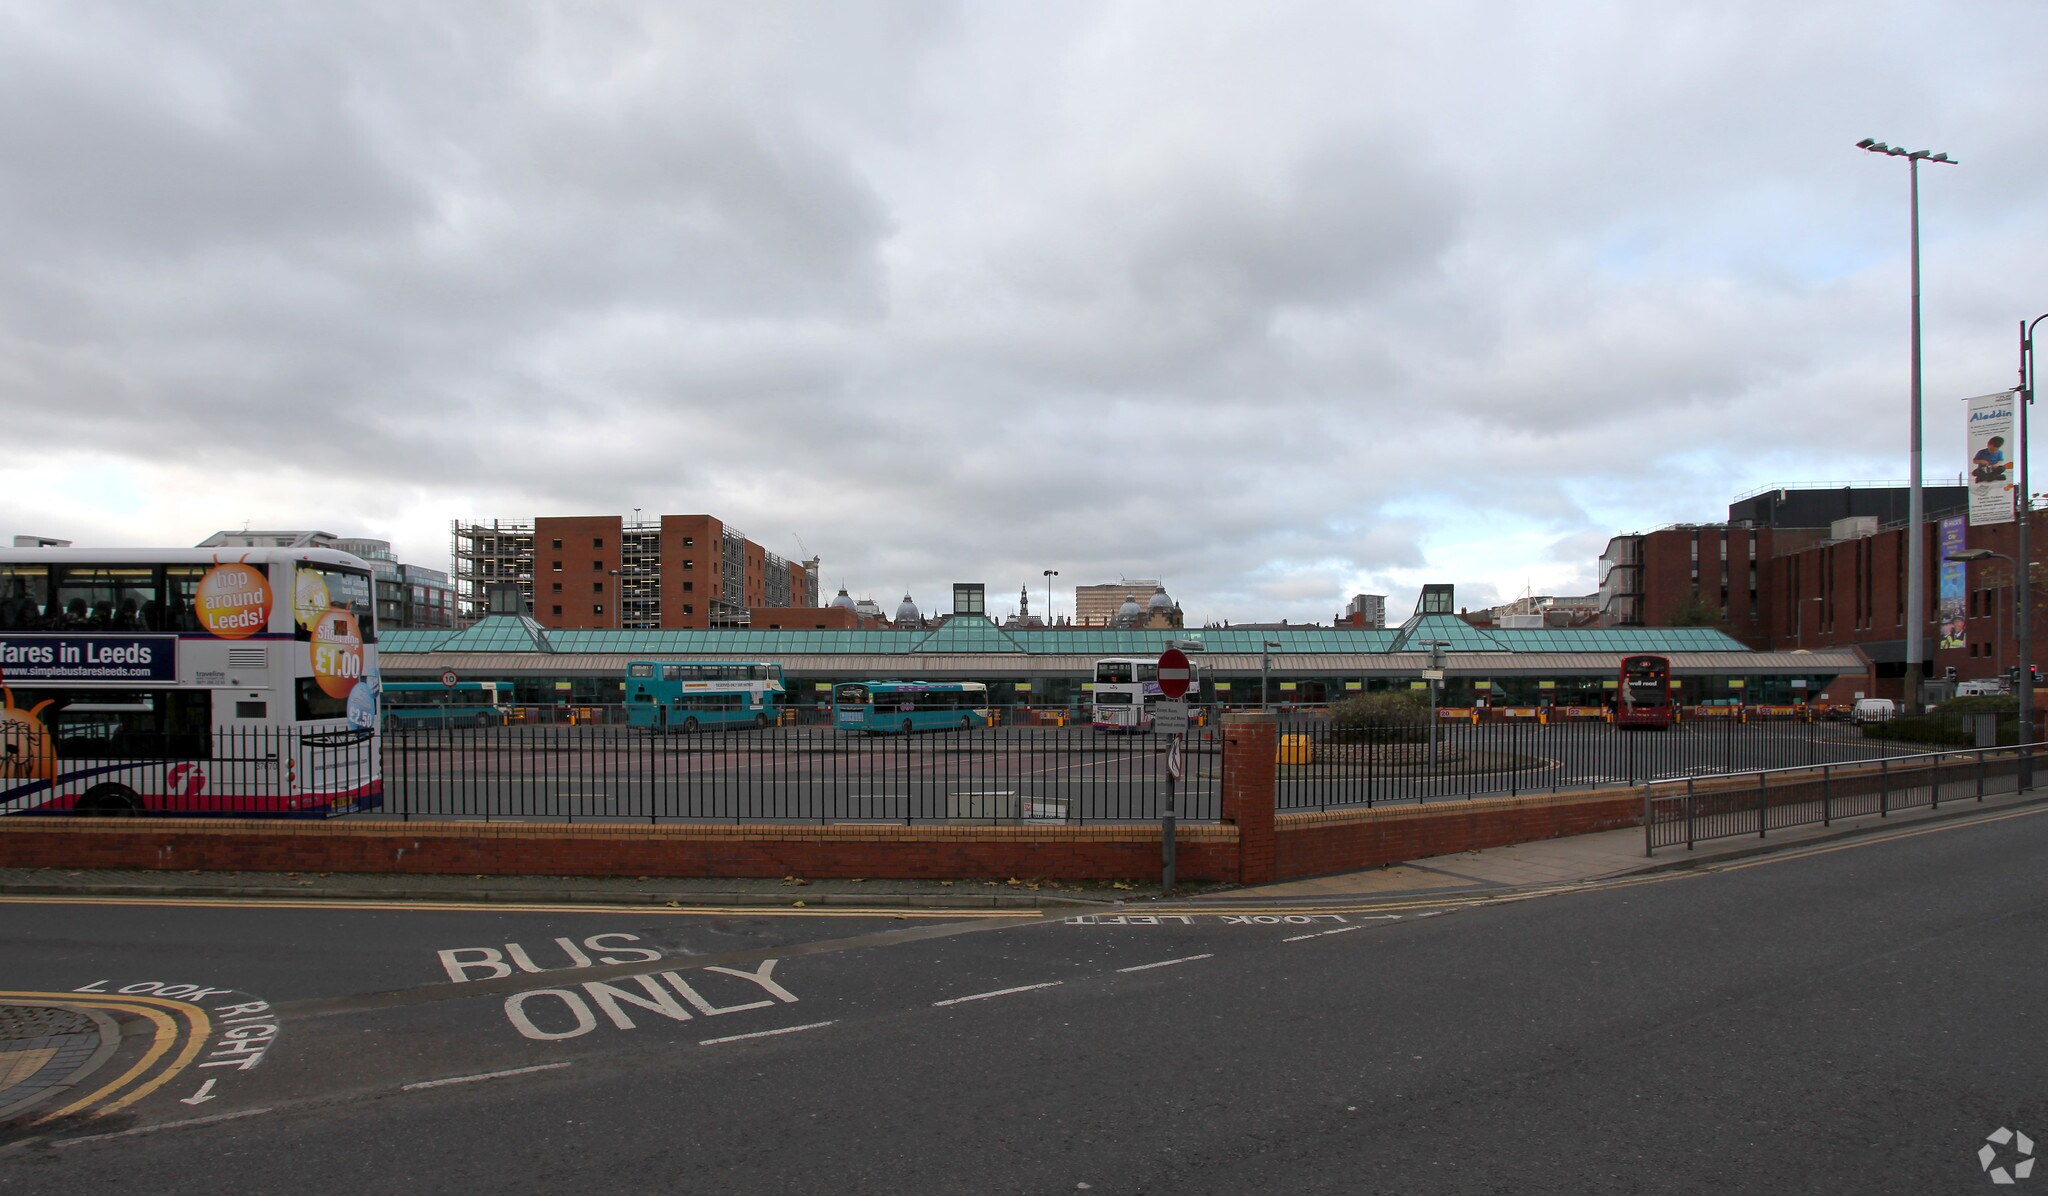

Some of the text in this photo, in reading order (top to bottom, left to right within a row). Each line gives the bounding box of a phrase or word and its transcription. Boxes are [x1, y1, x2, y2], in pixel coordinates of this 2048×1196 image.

[1969, 409, 2013, 423] Aladdin
[216, 571, 248, 589] hop
[205, 588, 264, 609] around
[208, 608, 264, 629] Leeds!
[0, 642, 152, 664] fares in Leeds
[316, 646, 360, 679] £1.00
[2, 666, 151, 677] www.simplebusfaresleeds.com
[445, 675, 455, 683] 10
[1065, 914, 1347, 925] LOOK LEFT
[437, 933, 662, 983] BUS
[504, 959, 799, 1040] ONLY
[72, 980, 278, 1070] LOOK RIGHT
